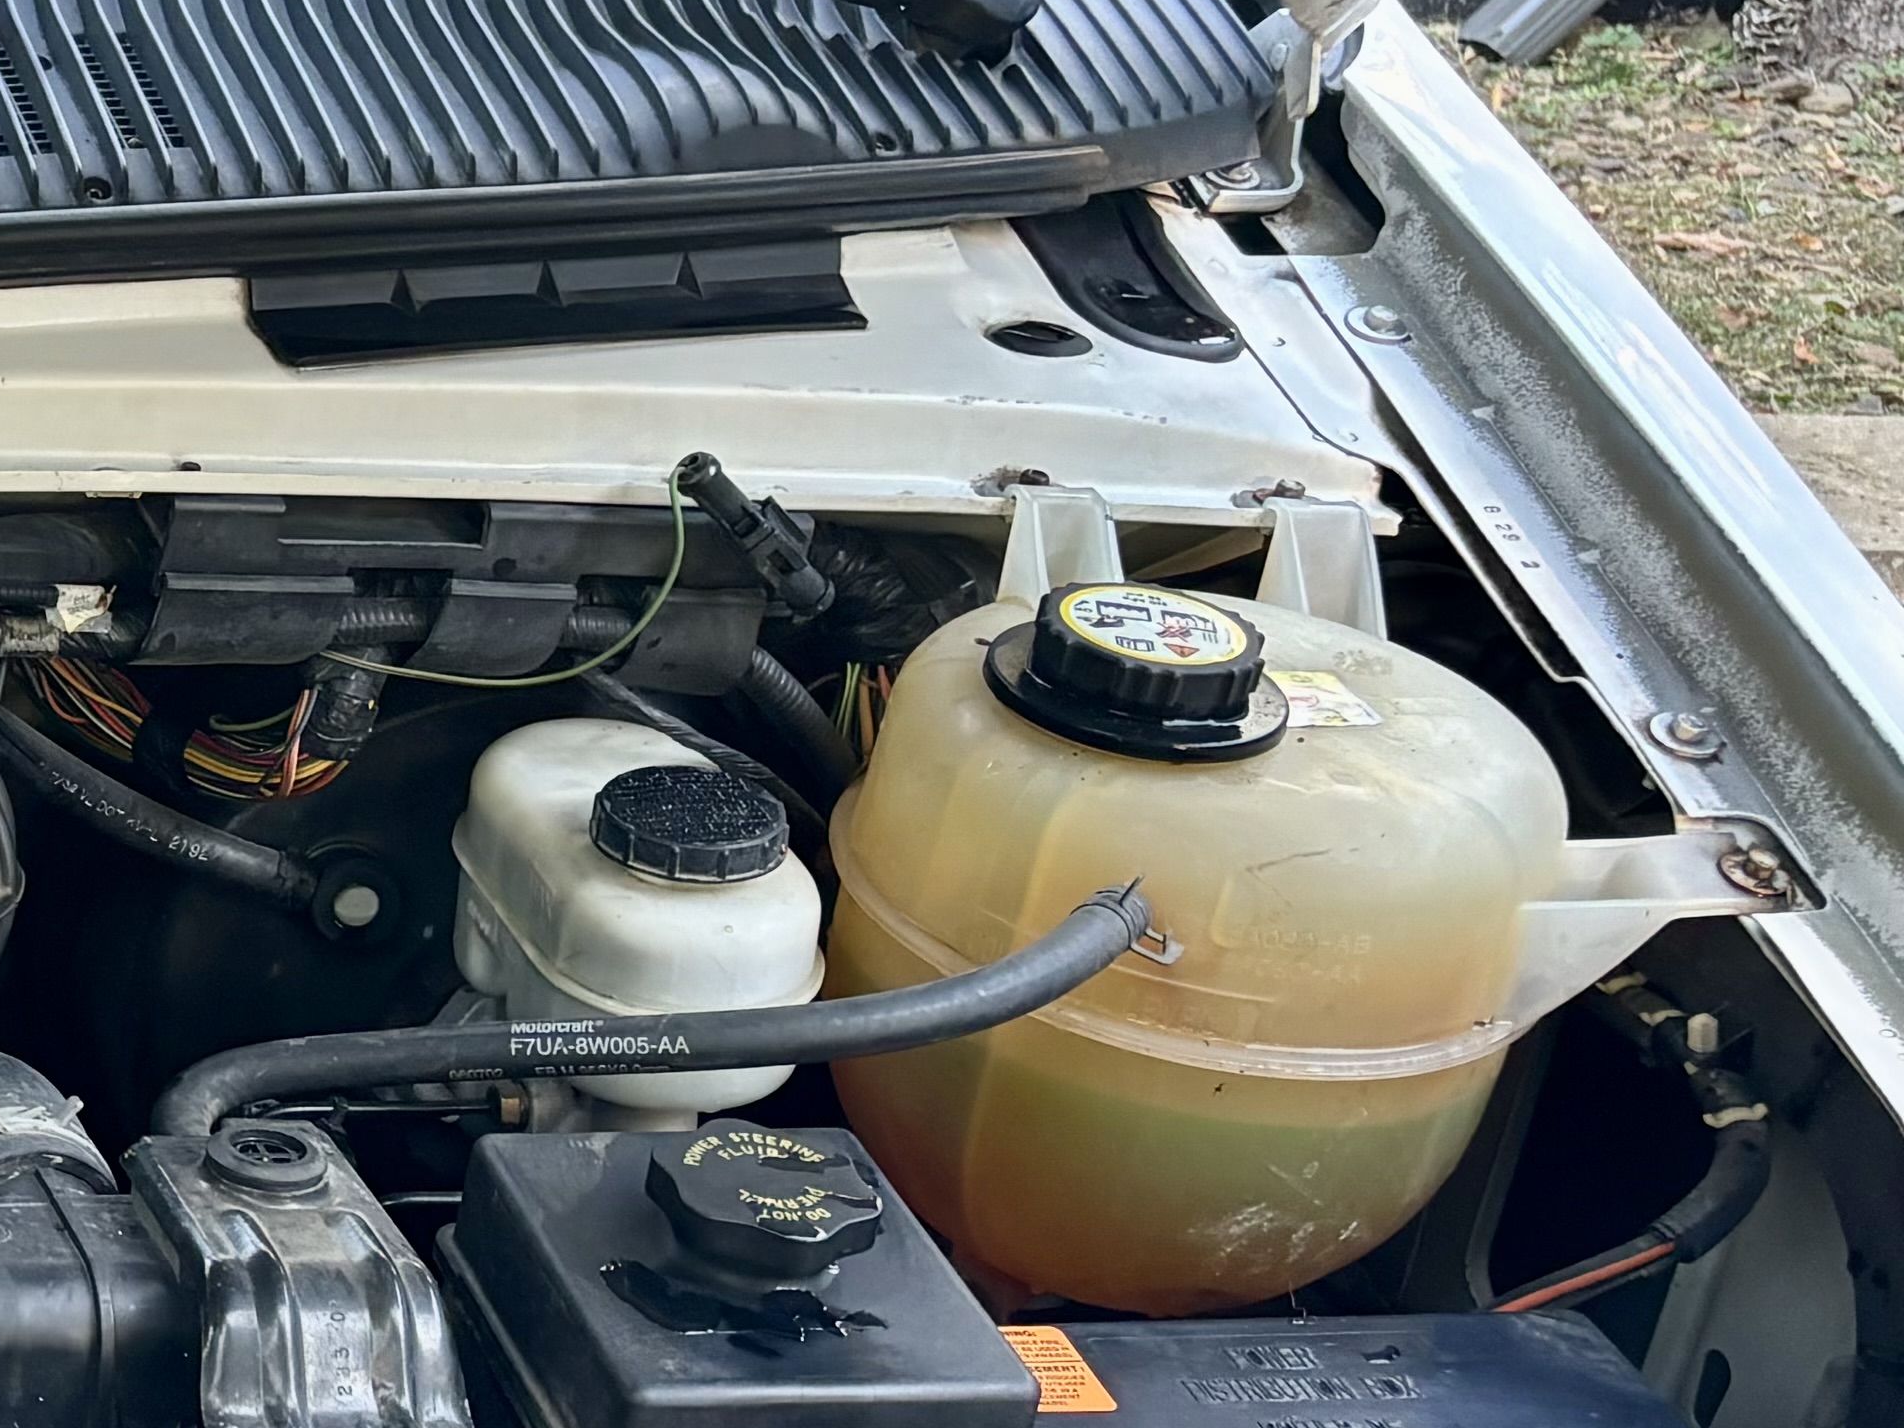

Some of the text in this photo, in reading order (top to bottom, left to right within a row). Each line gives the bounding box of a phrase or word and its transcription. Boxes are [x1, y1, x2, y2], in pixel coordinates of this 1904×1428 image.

[510, 1020, 595, 1035] Motorcraft
[510, 1035, 691, 1057] F7UA-8W005-AA
[682, 1135, 723, 1167] POWER
[717, 1144, 782, 1161] FLUID
[754, 1206, 833, 1223] DO NOT
[1223, 1346, 1322, 1370] POWER
[1180, 1374, 1426, 1404] DISTRIBUTION BOX
